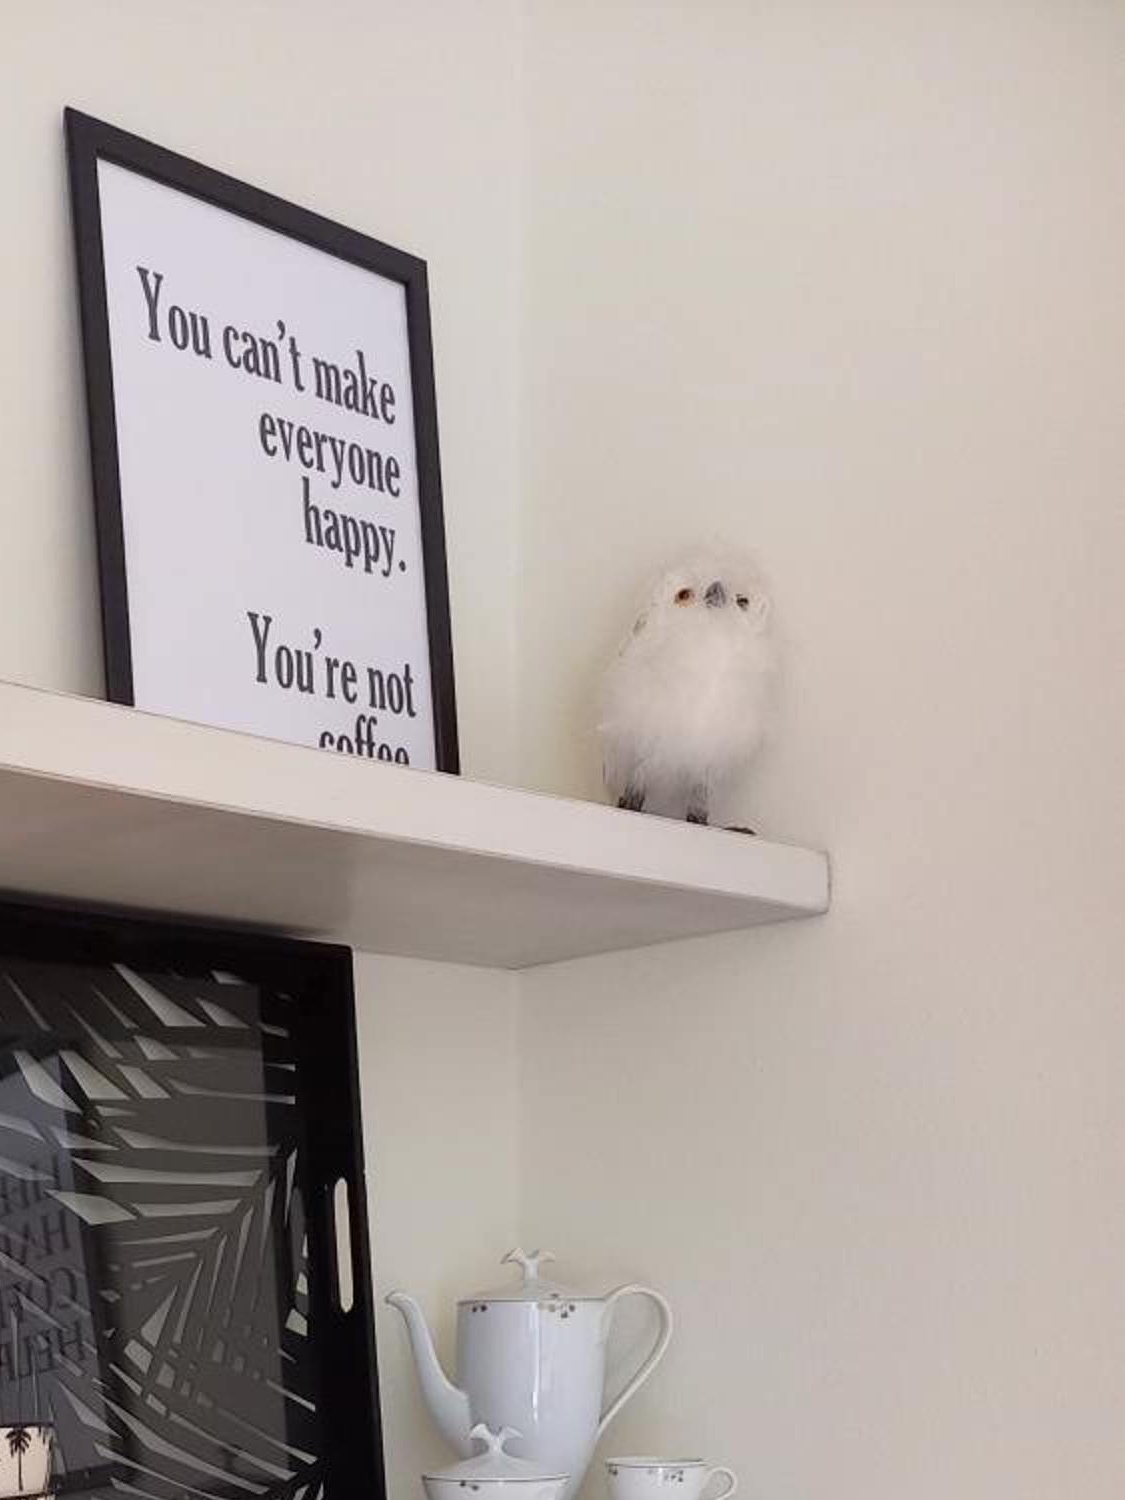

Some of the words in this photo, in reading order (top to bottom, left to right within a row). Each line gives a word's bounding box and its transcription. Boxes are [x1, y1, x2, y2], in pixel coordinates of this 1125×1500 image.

[136, 265, 212, 359] You
[223, 318, 305, 392] can't
[313, 350, 396, 425] make
[259, 412, 401, 498] everyone
[302, 475, 407, 578] happy.
[247, 611, 358, 705] You're
[367, 663, 417, 718] not
